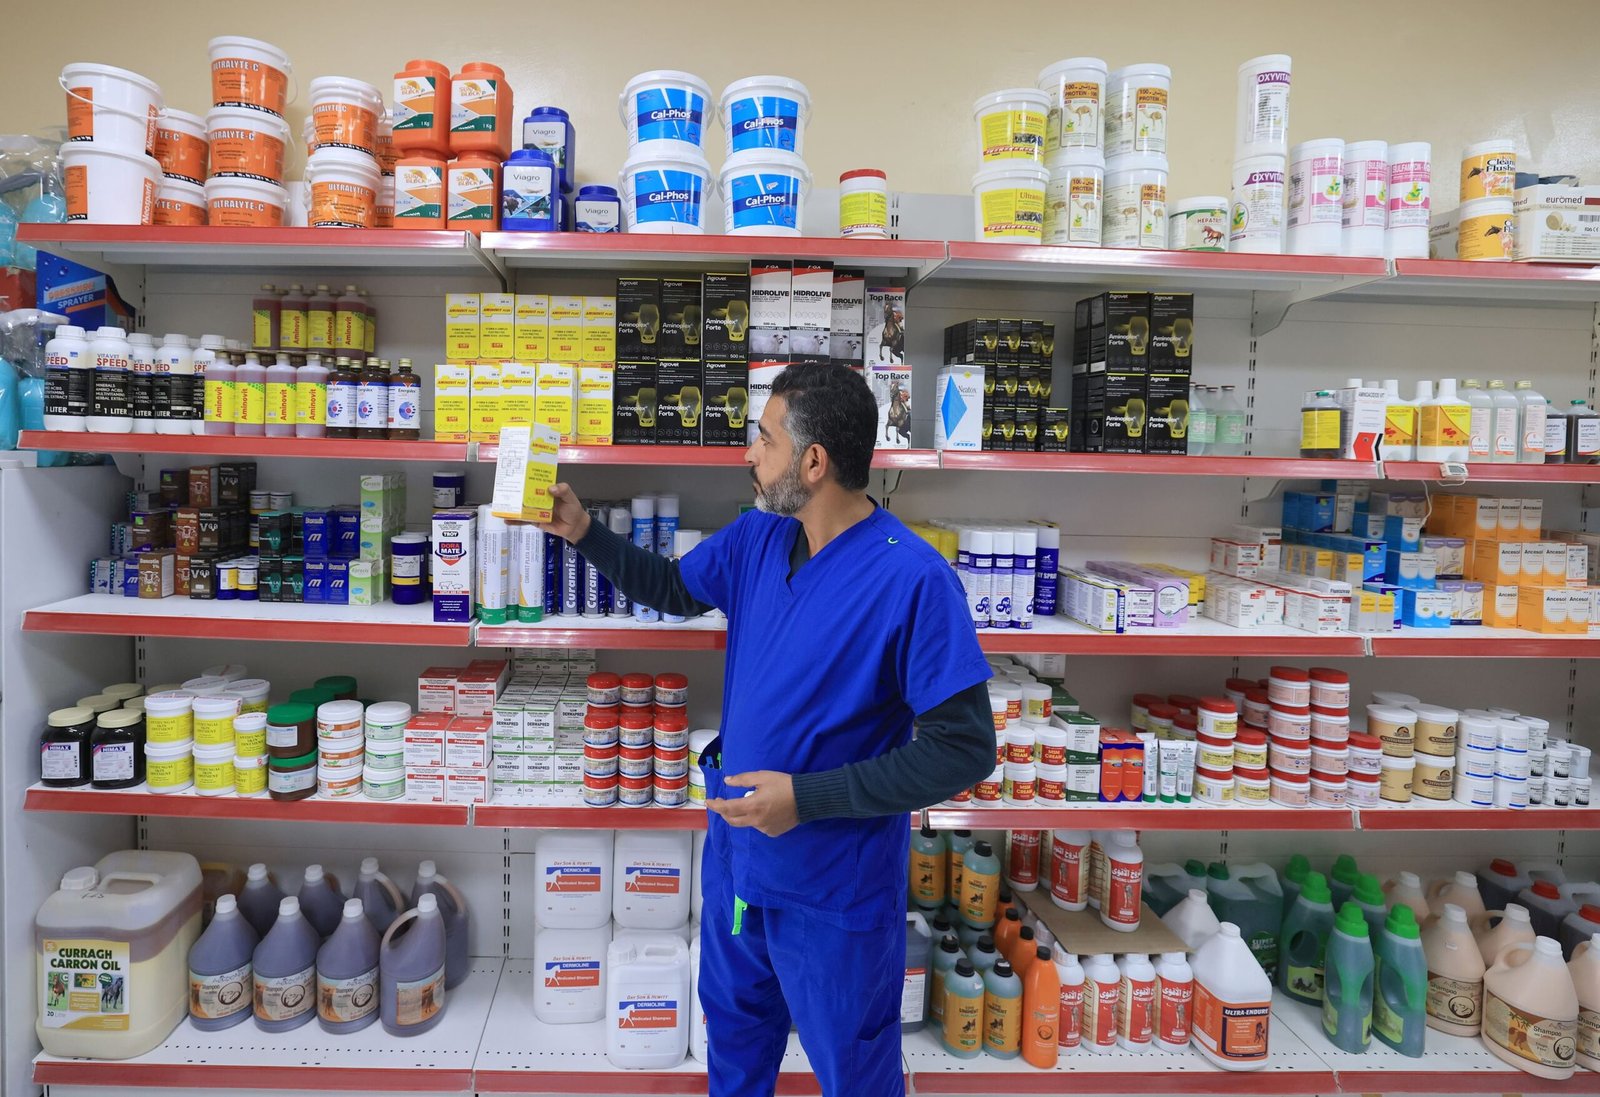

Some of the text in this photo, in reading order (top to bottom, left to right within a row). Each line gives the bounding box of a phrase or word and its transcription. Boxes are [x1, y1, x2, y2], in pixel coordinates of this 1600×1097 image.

[650, 109, 692, 121] Cal-Phos
[145, 107, 158, 150] Neospark
[743, 116, 785, 129] Cal-Phos
[533, 128, 556, 136] Viagro
[513, 174, 541, 183] Viagro
[142, 180, 154, 223] Neospark
[648, 190, 689, 203] Cal-Phos
[745, 194, 786, 207] Cal-Phos
[585, 208, 609, 216] Viagro
[707, 275, 727, 283] Agrovet
[751, 289, 790, 297] HIDROLIVE
[793, 289, 831, 297] HIDROLIVE
[869, 293, 903, 303] Top Race
[57, 293, 95, 310] SPRAYER
[345, 316, 353, 346] Aminovit
[96, 359, 128, 368] SPEED
[659, 361, 680, 369] Agrovet
[706, 362, 727, 370] Agrovet
[874, 372, 910, 382] Top Race
[215, 386, 223, 420] Aminovit
[241, 388, 249, 421] Aminovit
[280, 388, 288, 421] Aminovit
[308, 388, 317, 421] Aminovit
[49, 406, 68, 414] LITER
[110, 408, 128, 416] LITER
[566, 557, 577, 609] Curamic
[58, 947, 113, 960] CURRAGH
[50, 958, 121, 971] CARRON OIL
[1429, 982, 1458, 998] Shampoo
[637, 1001, 667, 1009] DERMOLINE
[1223, 1007, 1270, 1018] ULTRA-ENDURE
[1533, 1025, 1563, 1038] Shampoo
